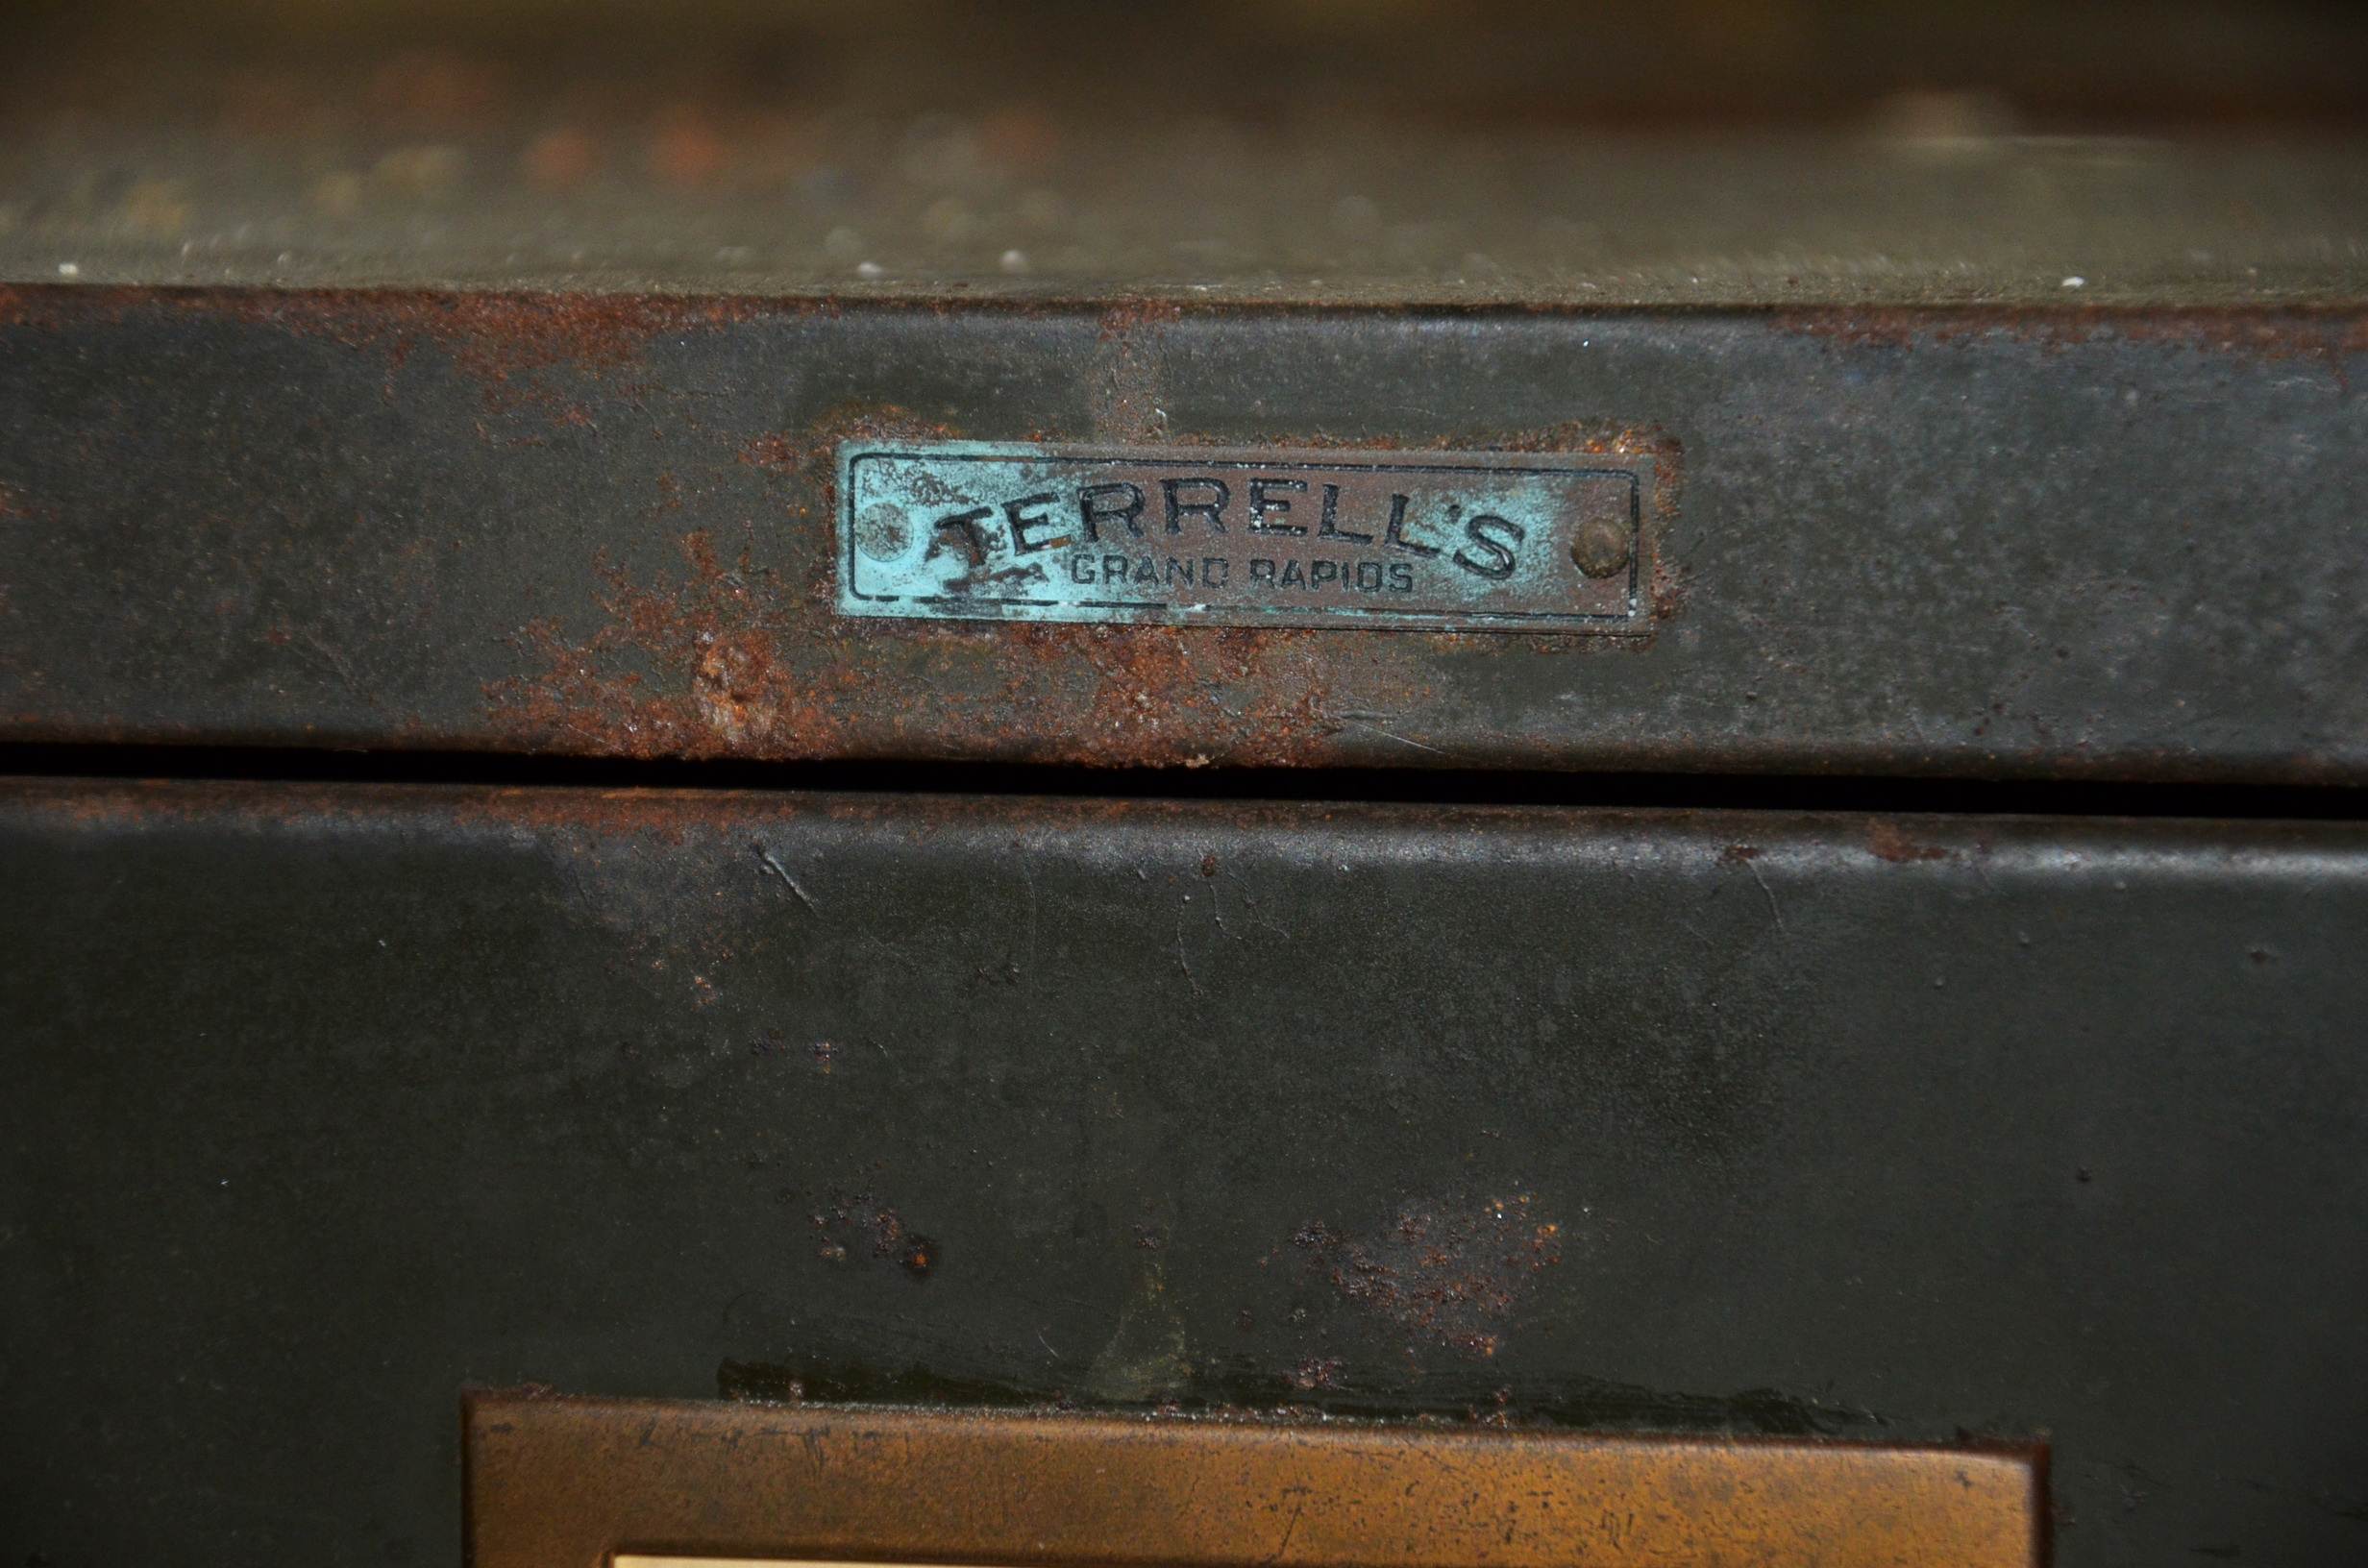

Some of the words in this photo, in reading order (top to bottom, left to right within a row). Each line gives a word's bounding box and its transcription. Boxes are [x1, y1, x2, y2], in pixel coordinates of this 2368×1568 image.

[934, 477, 1525, 579] TERRELL'S
[1071, 553, 1229, 589] GRAND
[1250, 558, 1414, 593] RAPIDS
